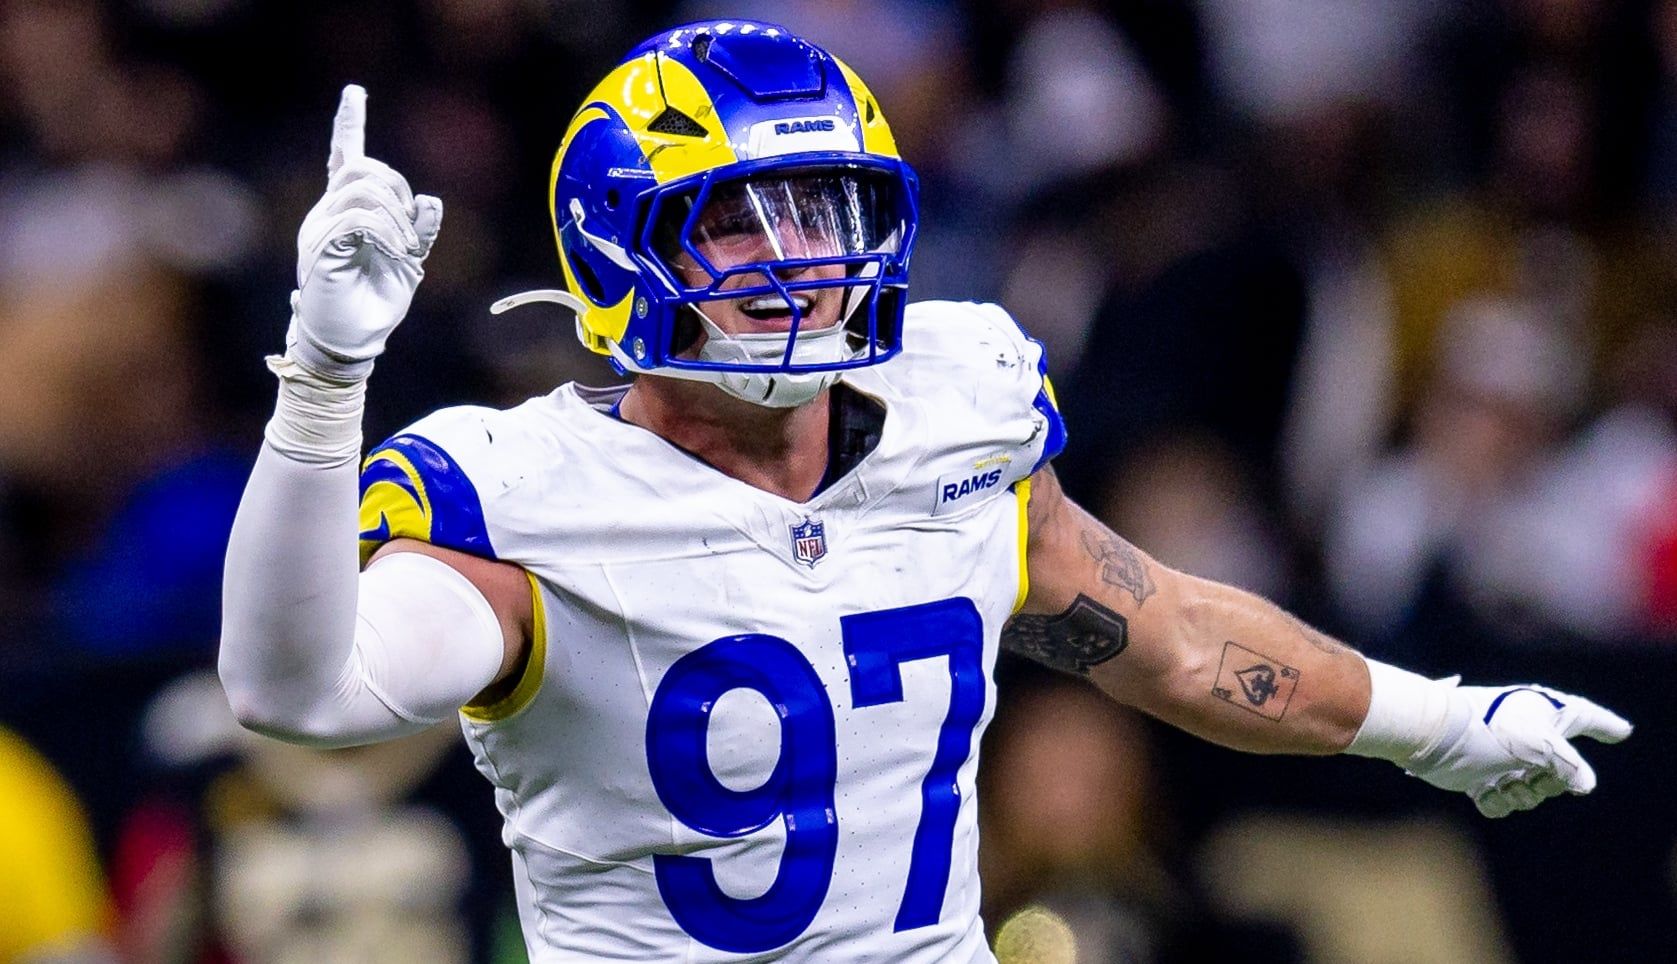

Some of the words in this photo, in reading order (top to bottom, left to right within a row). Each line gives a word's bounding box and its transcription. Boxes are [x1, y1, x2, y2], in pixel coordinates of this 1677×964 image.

[775, 120, 835, 135] RAMS
[942, 469, 1002, 503] RAMS
[798, 539, 823, 558] NFL
[645, 596, 985, 953] 97
